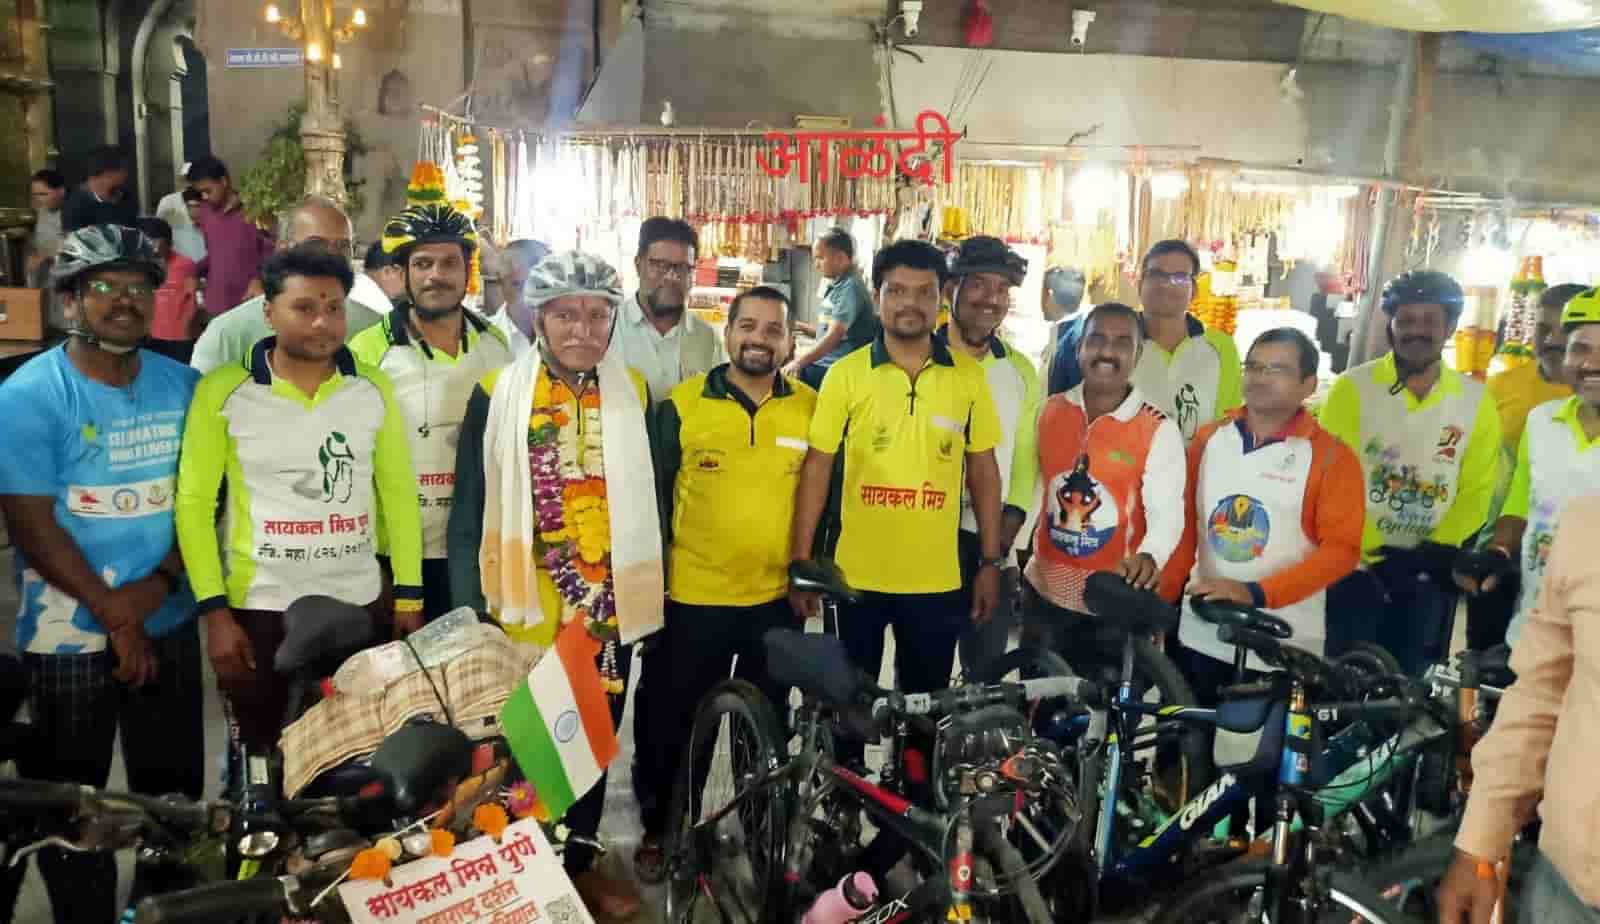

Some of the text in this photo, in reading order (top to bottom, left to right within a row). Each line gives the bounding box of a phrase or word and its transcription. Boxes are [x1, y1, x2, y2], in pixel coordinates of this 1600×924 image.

[419, 473, 456, 486] सायक
[862, 481, 946, 511] सायकल मित्र
[263, 520, 324, 535] सायकल
[328, 513, 356, 535] मित्र
[1179, 772, 1237, 832] GIAN
[365, 832, 538, 919] सायकल मित्र पुणे
